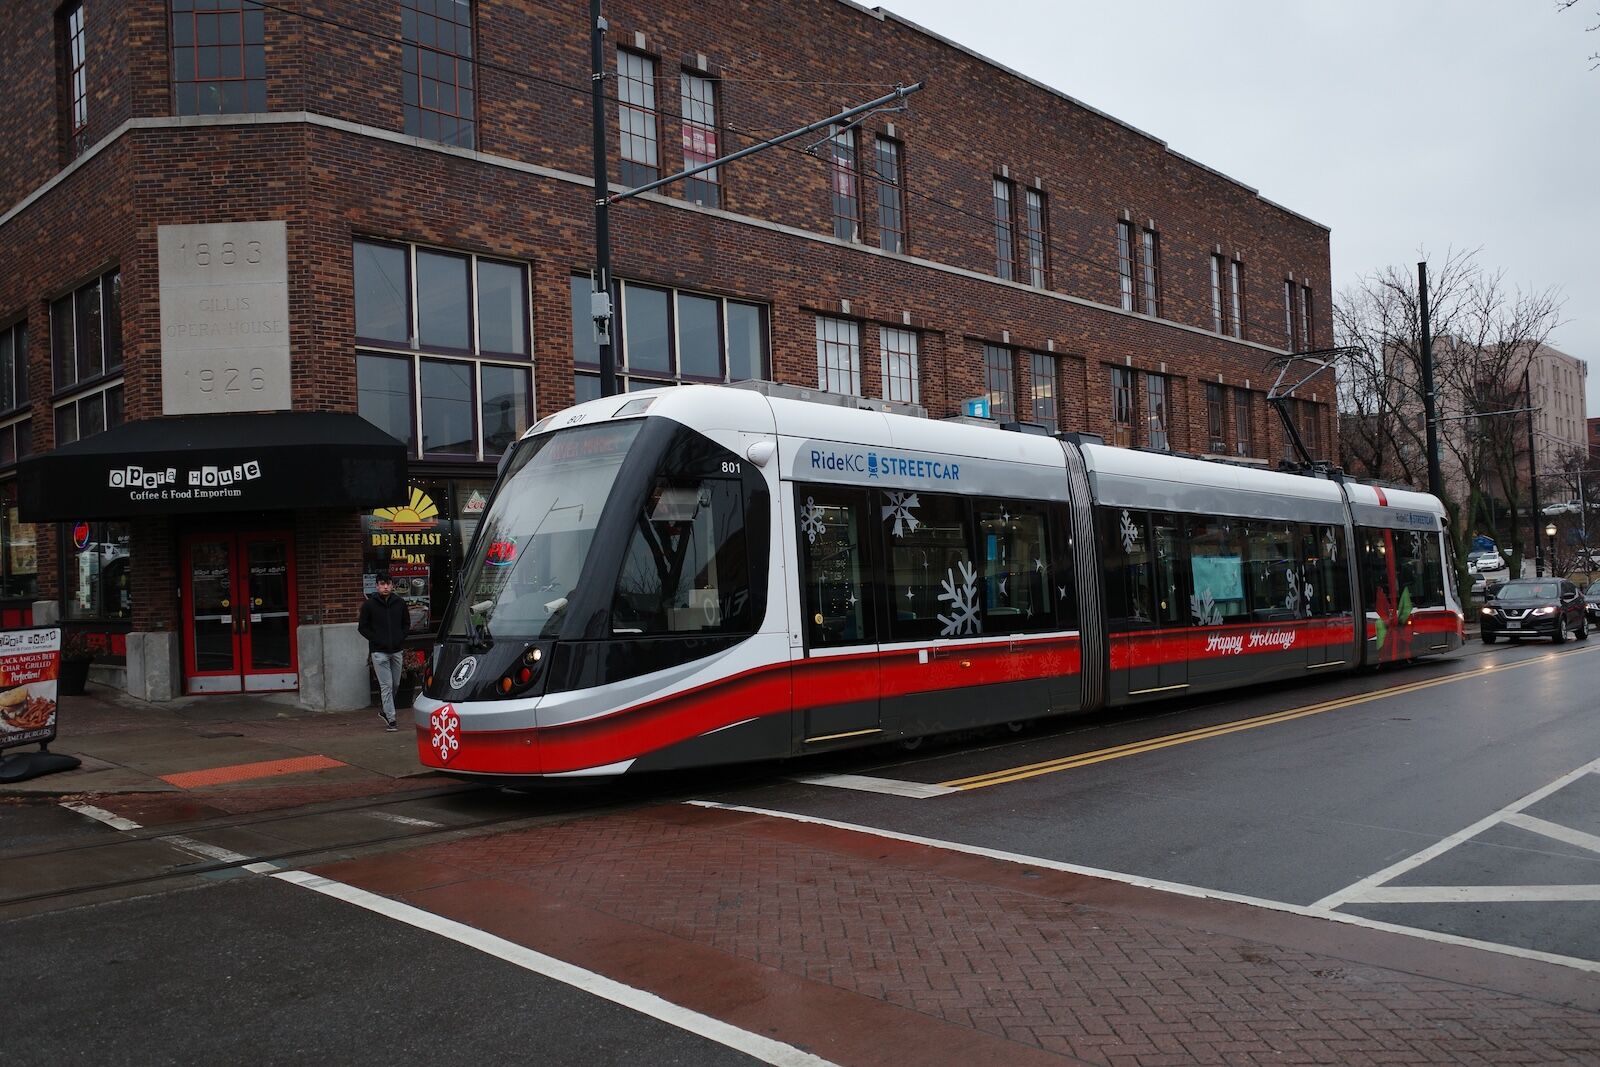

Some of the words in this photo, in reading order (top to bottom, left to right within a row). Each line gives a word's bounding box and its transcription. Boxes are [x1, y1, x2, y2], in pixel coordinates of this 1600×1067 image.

[179, 240, 262, 267] 1883
[199, 297, 250, 312] GILLIS
[166, 322, 221, 338] OPERA
[229, 320, 284, 335] HOUSE
[183, 367, 265, 393] 1926
[567, 414, 585, 424] 801
[721, 461, 741, 473] 801
[811, 450, 864, 472] RideKC
[881, 457, 960, 480] STREETCAR
[130, 490, 159, 501] Coffee
[161, 490, 169, 499] &
[170, 489, 192, 500] Food
[193, 488, 242, 499] Emporium
[371, 533, 442, 546] BREAKFAST
[390, 548, 408, 561] ALL
[407, 553, 426, 564] DAY
[1206, 632, 1243, 655] Happy
[1248, 629, 1296, 649] Holidays
